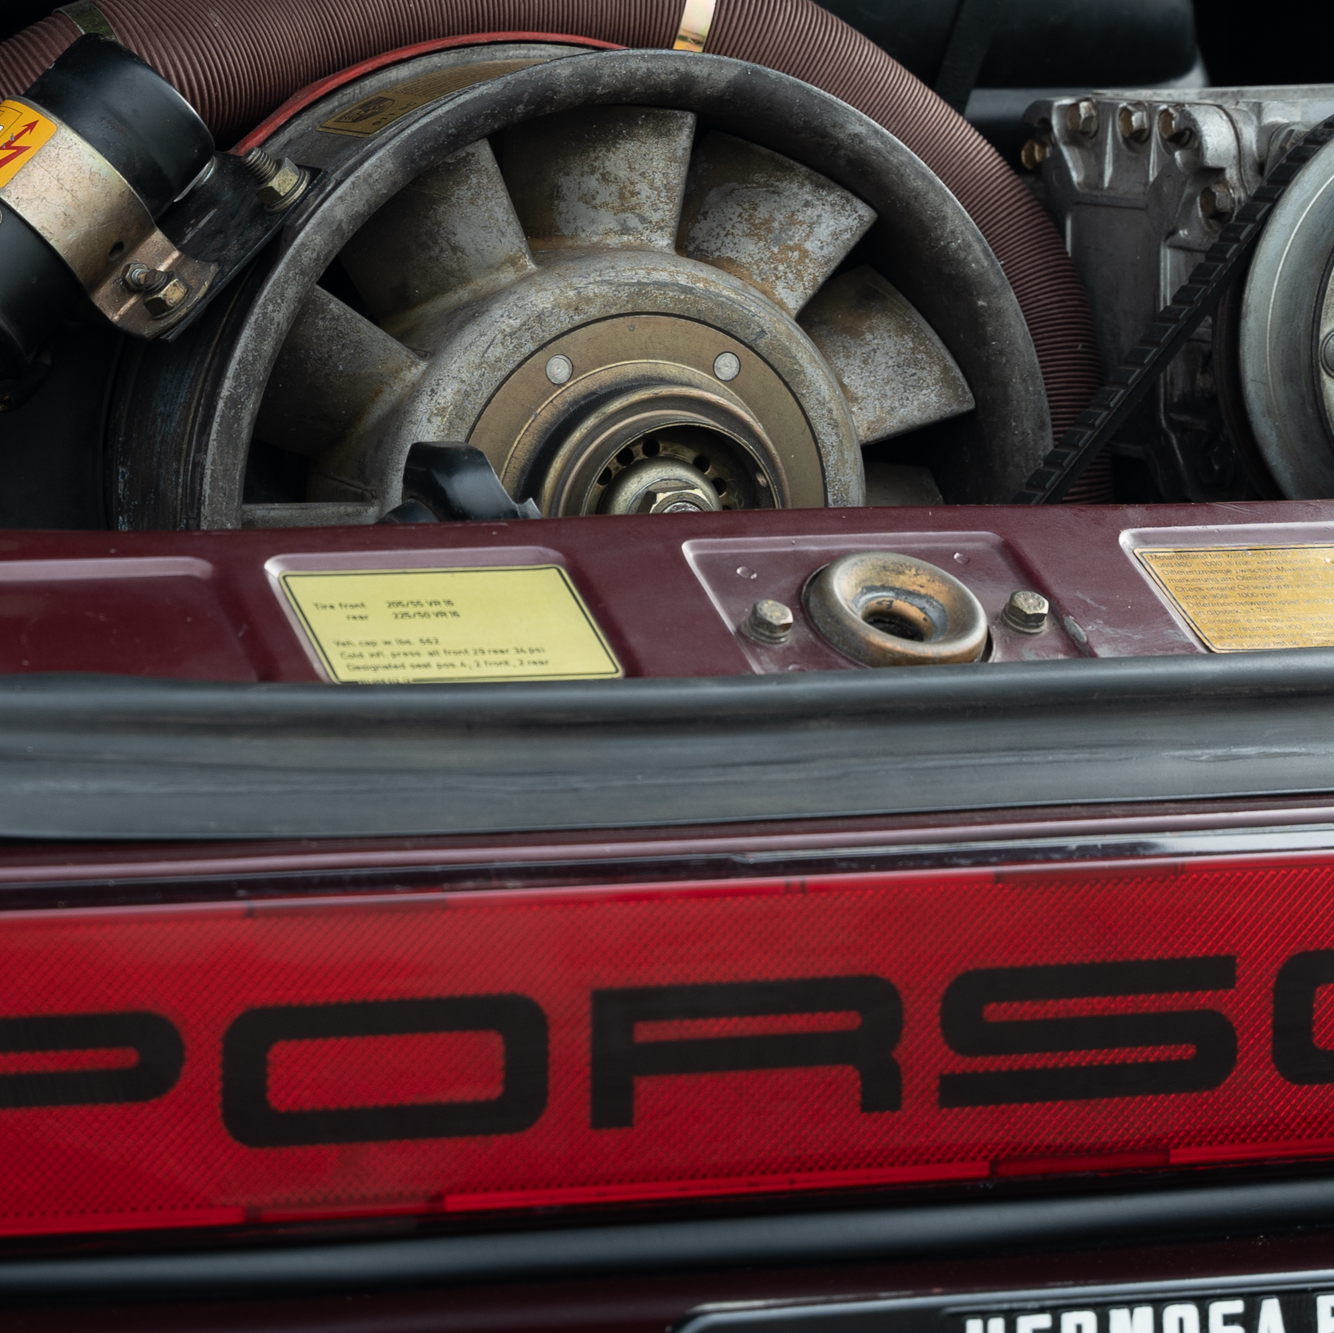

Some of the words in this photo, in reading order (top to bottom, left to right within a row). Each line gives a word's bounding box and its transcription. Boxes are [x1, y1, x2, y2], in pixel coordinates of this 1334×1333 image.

[1201, 559, 1223, 567] 1000
[1174, 584, 1205, 593] Check
[1205, 583, 1237, 593] engine
[1237, 591, 1259, 599] 1000
[313, 601, 337, 611] Tire
[338, 600, 368, 611] front
[385, 598, 425, 610] 205/55
[425, 597, 441, 609] VR
[441, 596, 456, 608] 16
[1186, 600, 1234, 609] Difference
[1234, 598, 1274, 607] between
[345, 613, 370, 622] rear
[392, 610, 432, 621] 225/50
[432, 609, 448, 620] VR
[448, 609, 462, 619] 16
[339, 649, 365, 661] Cold
[426, 648, 440, 658] all
[442, 647, 469, 658] front
[487, 646, 510, 657] rear
[527, 645, 547, 657] psi
[345, 662, 407, 673] Designated
[408, 660, 432, 670] seat
[517, 658, 526, 668] 2
[526, 658, 550, 668] rear
